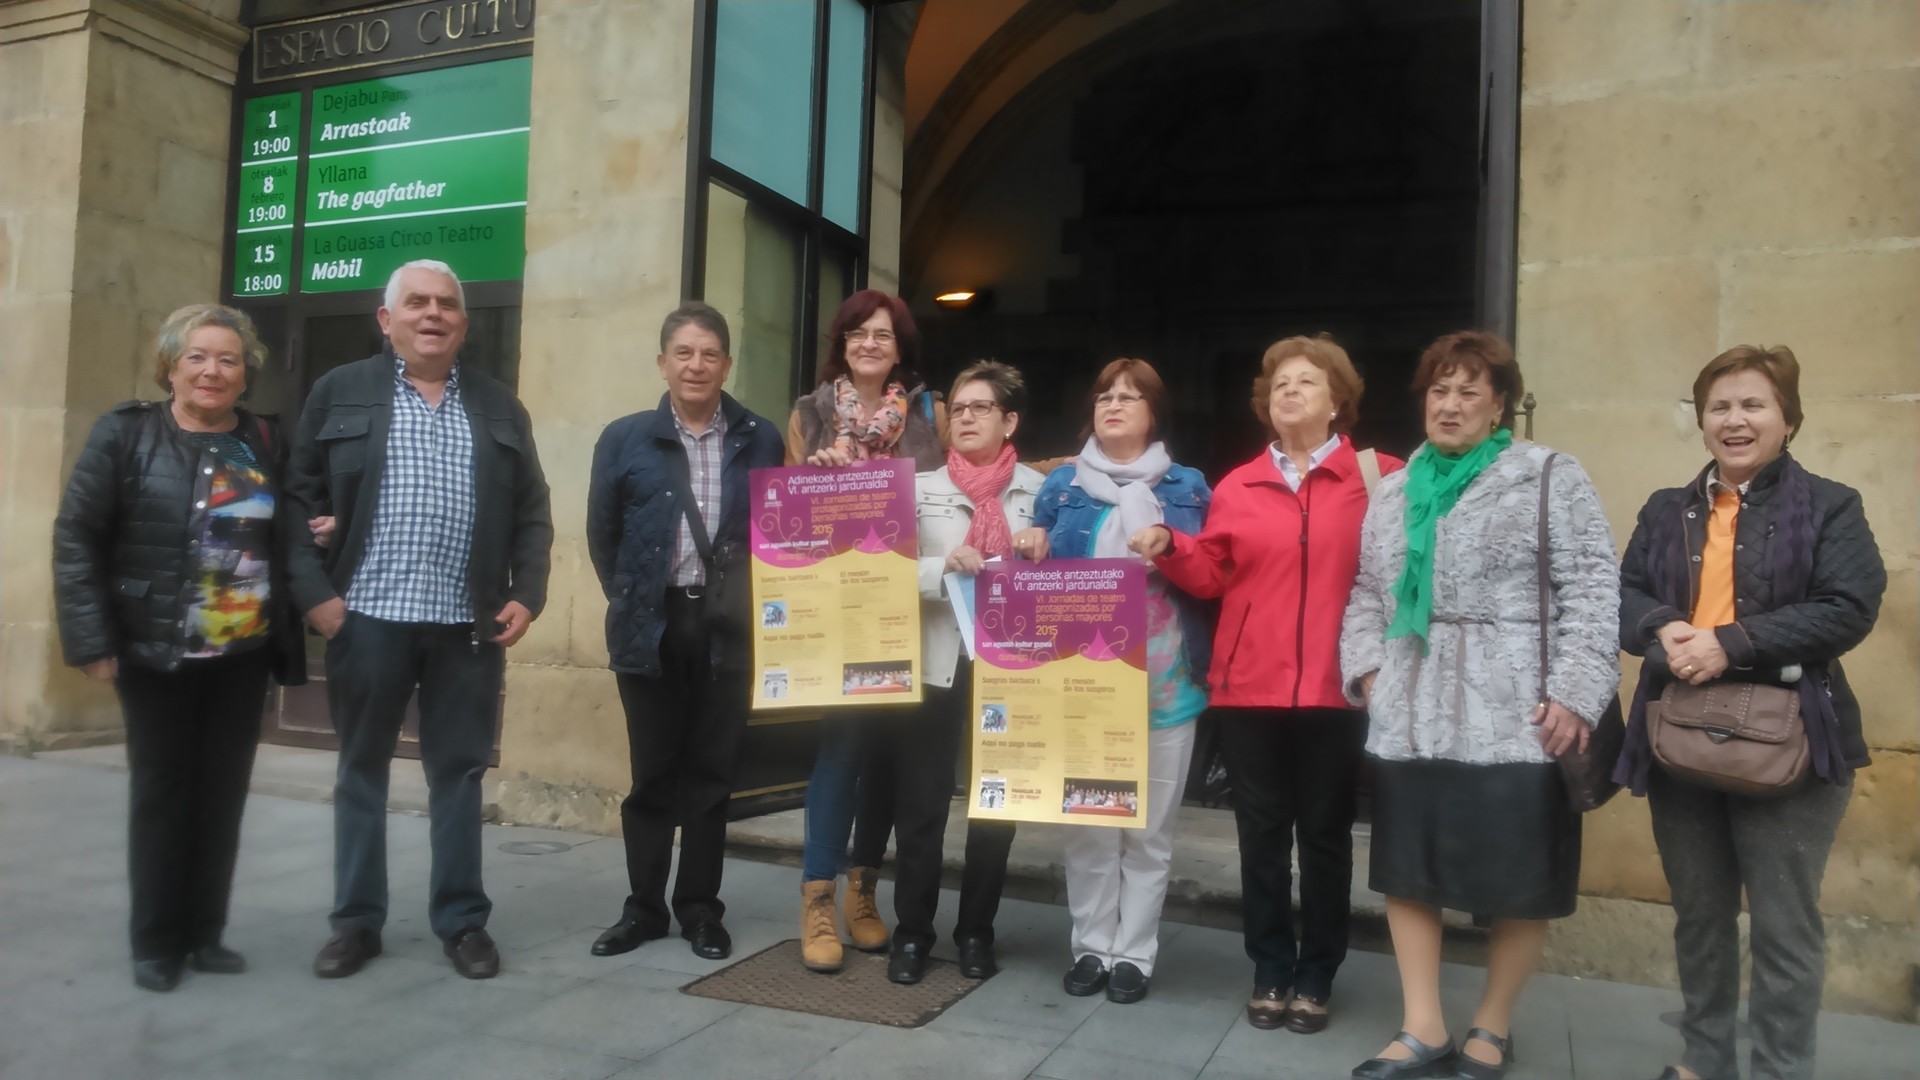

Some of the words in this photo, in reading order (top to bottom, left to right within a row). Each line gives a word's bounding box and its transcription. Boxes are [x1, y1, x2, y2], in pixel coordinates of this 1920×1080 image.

[262, 18, 390, 70] ESPACIO
[322, 88, 379, 113] Dejabu
[268, 110, 277, 128] 1
[320, 111, 412, 141] Arrastoak
[253, 136, 291, 156] 19:00
[318, 163, 367, 184] Yllana
[263, 175, 274, 193] 8
[251, 192, 285, 204] febrero
[317, 190, 349, 210] The
[351, 180, 446, 211] gagfather
[248, 204, 286, 223] 19:00
[314, 236, 331, 255] La
[336, 231, 385, 253] Guasa
[391, 227, 432, 248] Circo
[438, 223, 494, 244] Teatro
[254, 244, 275, 263] 15
[311, 258, 363, 281] Móbil
[244, 273, 282, 292] 18:00
[788, 473, 835, 485] Adinekoek
[837, 469, 894, 482] antzeztutako
[801, 482, 837, 494] antzerki
[839, 479, 889, 493] jardunaldia
[874, 501, 888, 511] por
[812, 524, 834, 536] 2015
[1014, 570, 1062, 581] Adinekoek
[1064, 569, 1124, 580] antzeztutako
[1014, 582, 1025, 591] VI.
[1027, 581, 1063, 591] antzerki
[1065, 580, 1118, 592] jardunaldia
[1048, 594, 1084, 603] Jornadas
[1088, 594, 1098, 603] de
[1100, 594, 1126, 603] teatro
[1035, 603, 1099, 615] protagonizadas
[1101, 604, 1117, 614] por
[1035, 614, 1074, 624] personas
[1076, 614, 1113, 624] mayores
[1035, 625, 1058, 636] 2015
